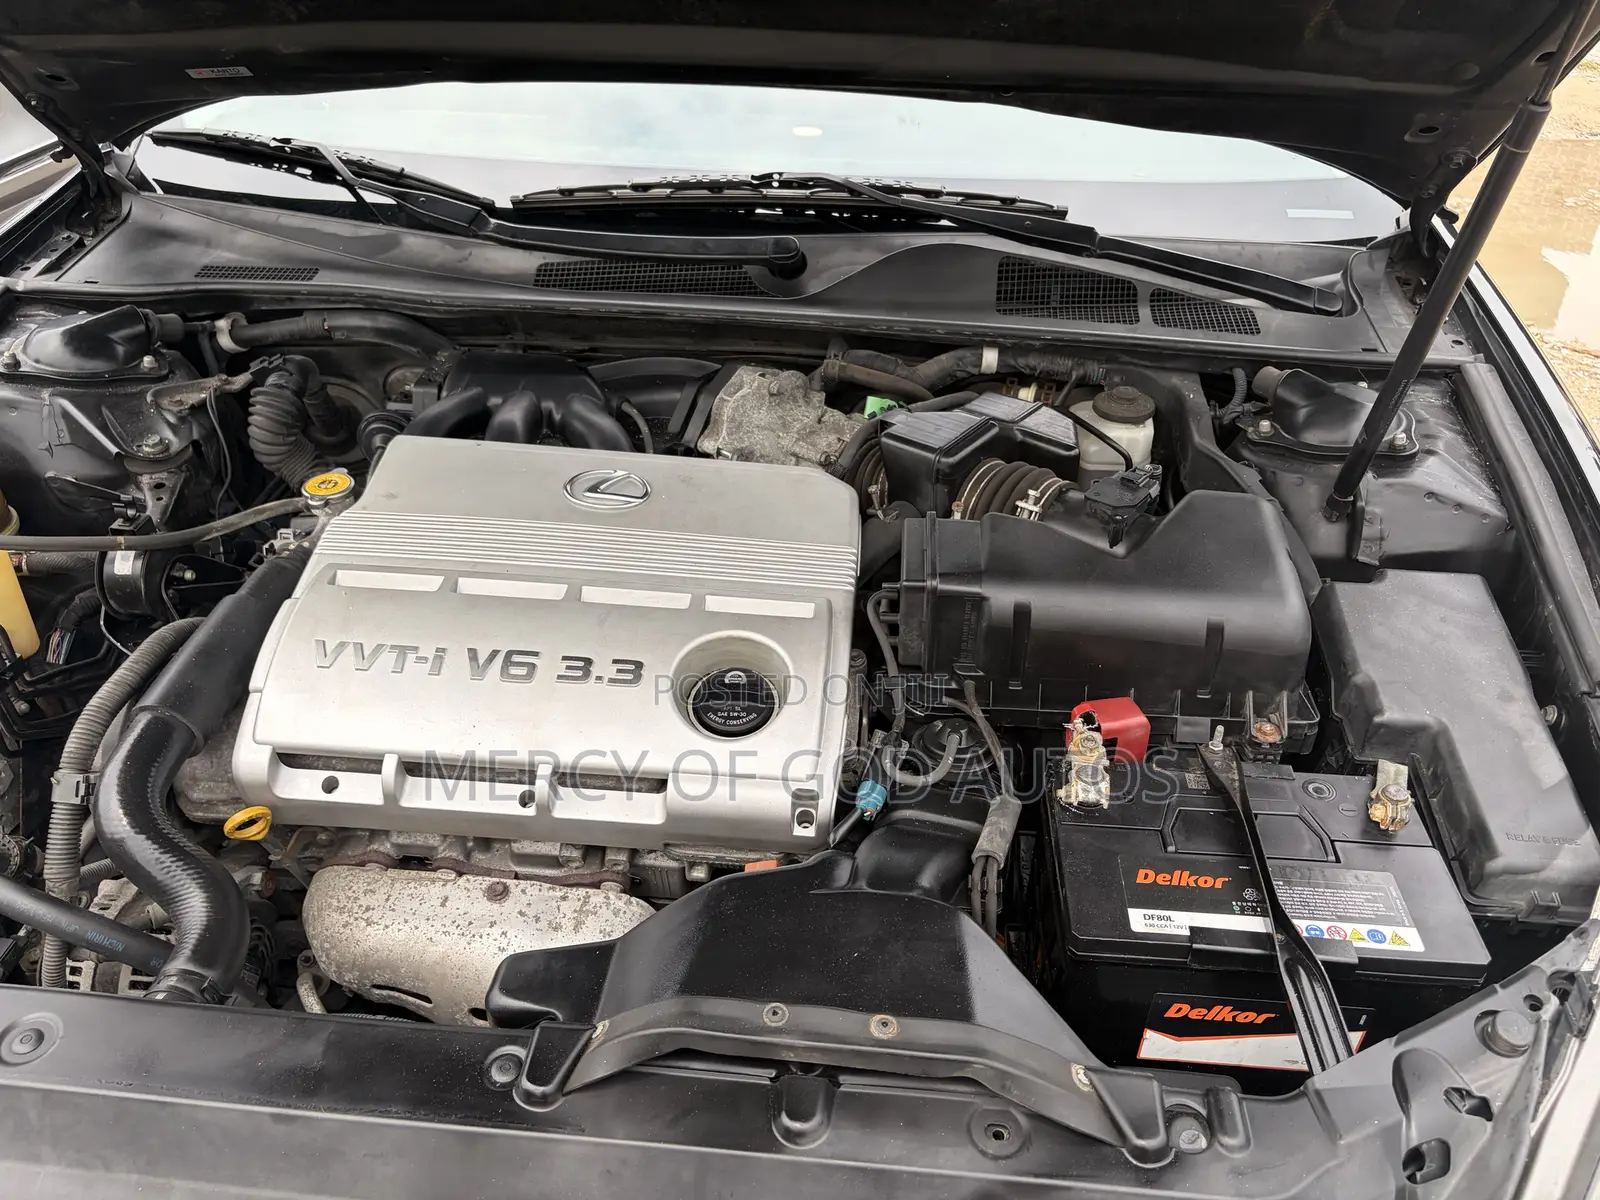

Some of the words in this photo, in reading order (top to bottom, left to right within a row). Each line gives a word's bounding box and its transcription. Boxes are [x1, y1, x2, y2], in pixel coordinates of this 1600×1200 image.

[314, 638, 448, 677] VVT-i
[466, 647, 544, 685] V6
[555, 654, 645, 688] 3.3
[707, 712, 725, 723] ENERGY
[726, 713, 757, 724] CONSERVING
[1505, 832, 1540, 843] RELAY
[1135, 868, 1229, 889] Delkor
[1143, 914, 1175, 923] DF80L
[1164, 1002, 1276, 1024] Delkor
